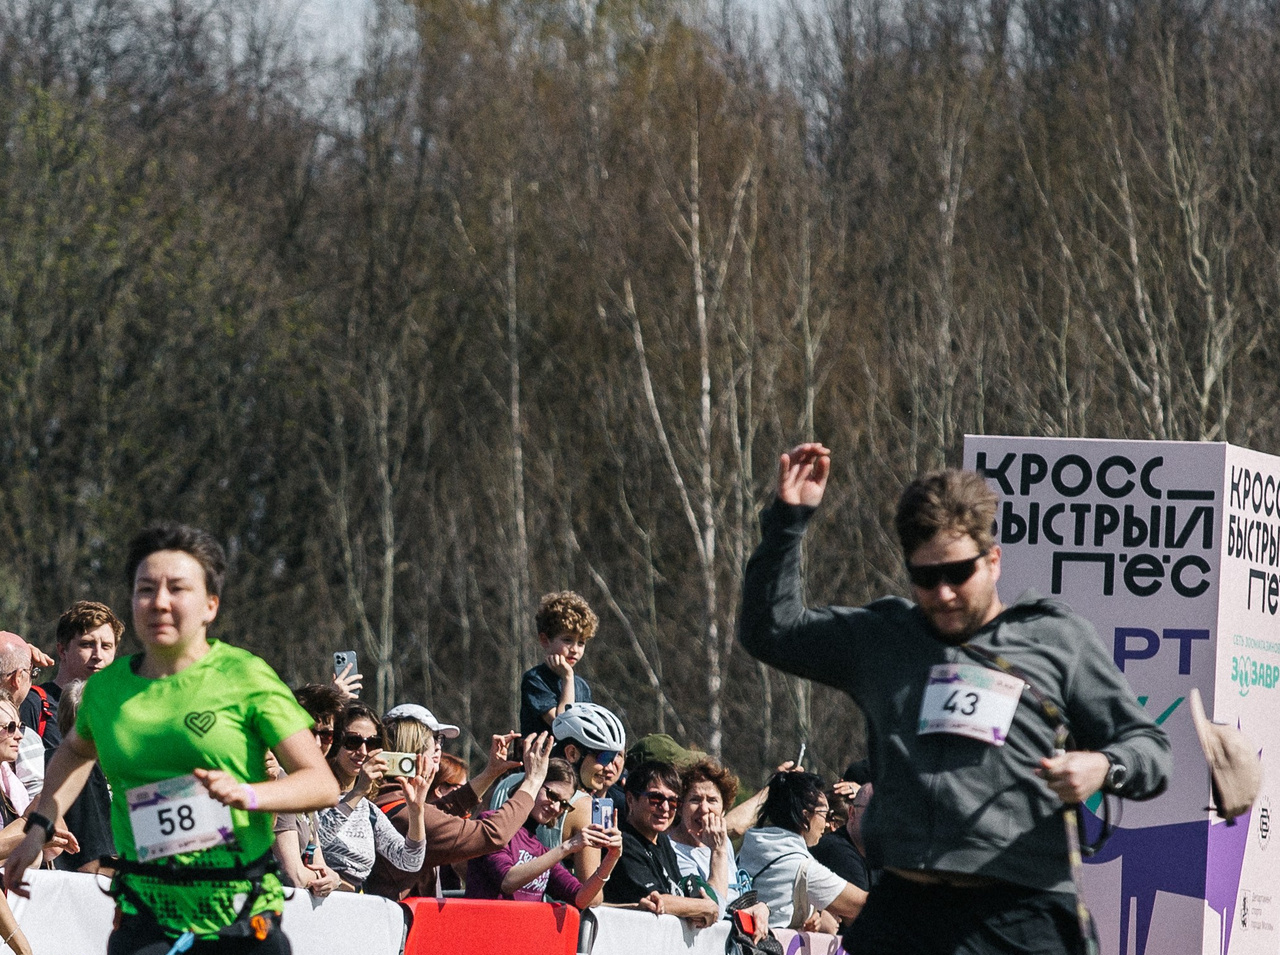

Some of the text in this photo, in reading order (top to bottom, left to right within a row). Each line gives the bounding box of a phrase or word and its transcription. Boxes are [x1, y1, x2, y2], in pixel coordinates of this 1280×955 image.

[976, 452, 1164, 500] КРОСС
[990, 501, 1214, 549] ЫСТРЫЙ
[1227, 514, 1280, 568] БЫСТРЫ
[943, 690, 979, 716] 43
[157, 804, 196, 836] 58
